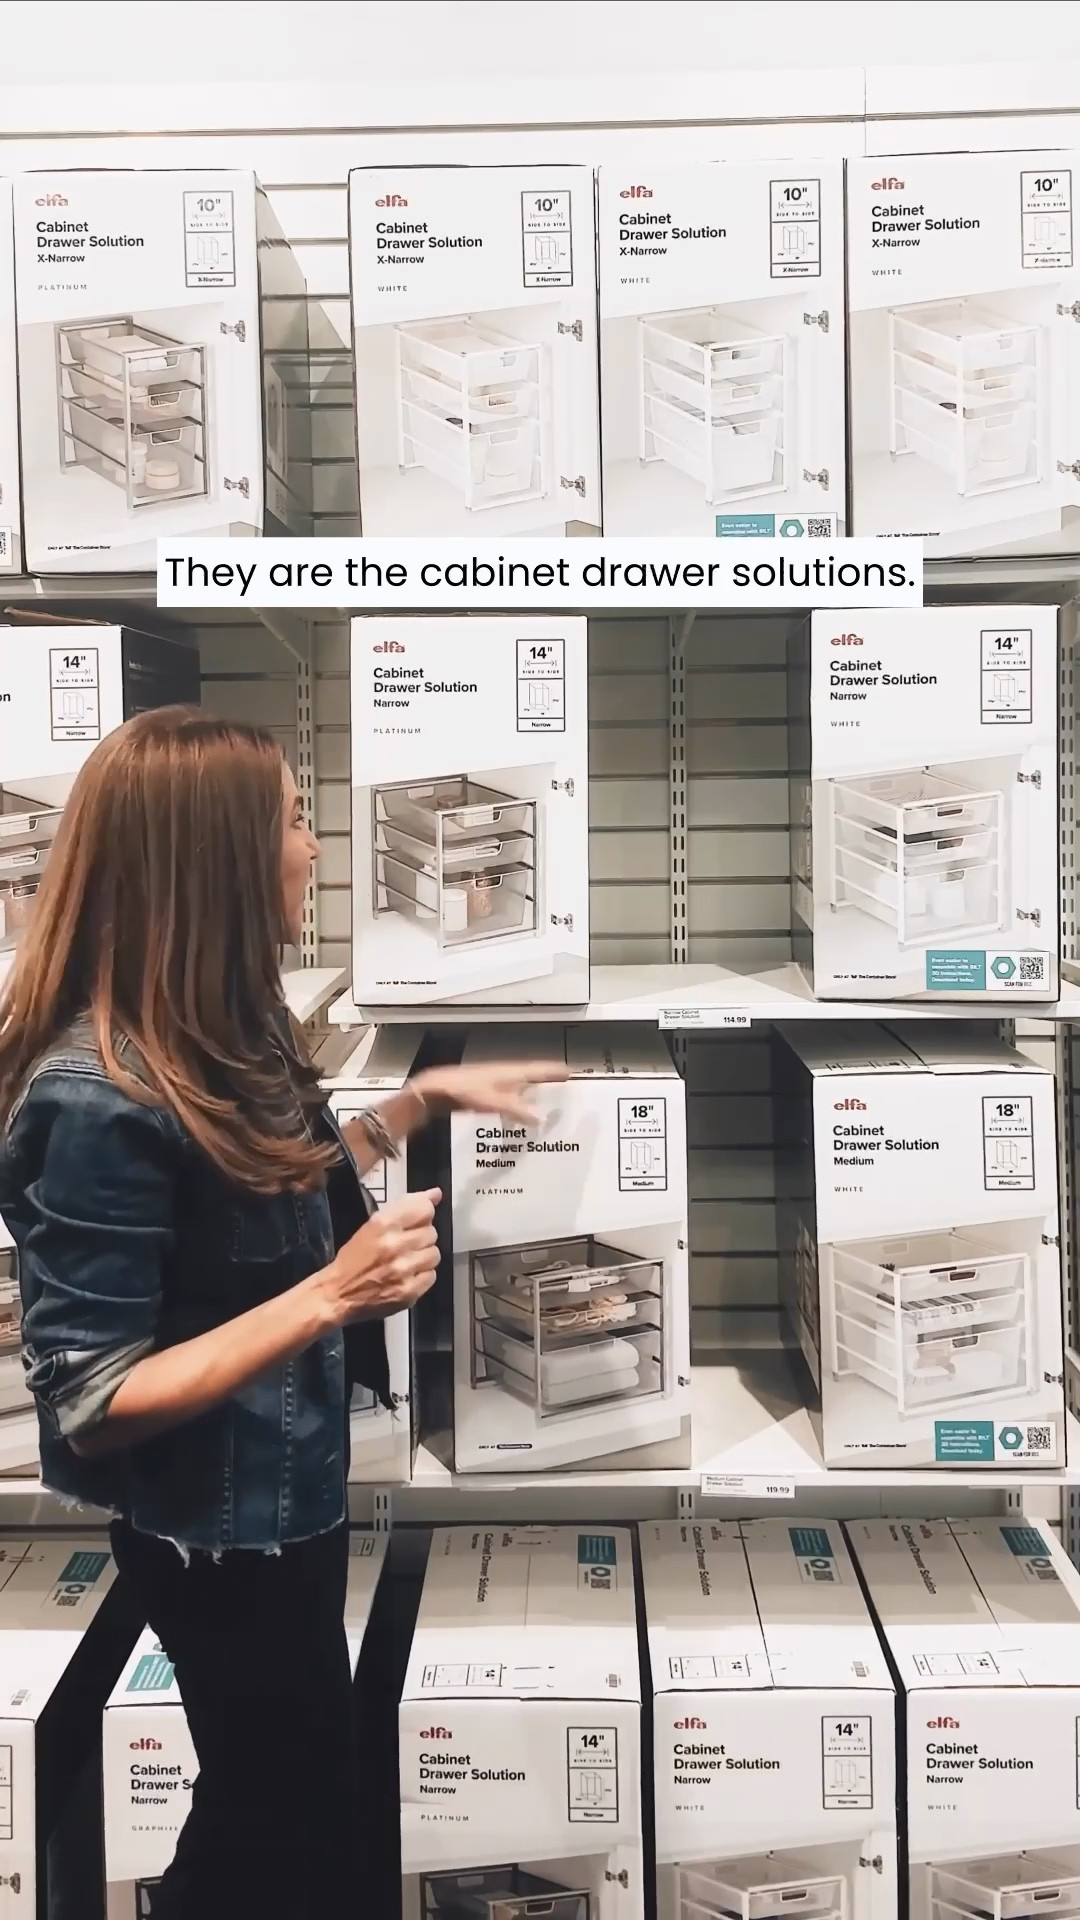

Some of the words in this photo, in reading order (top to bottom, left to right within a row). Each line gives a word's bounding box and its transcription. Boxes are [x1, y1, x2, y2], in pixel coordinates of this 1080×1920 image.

[871, 177, 905, 191] elfa
[619, 186, 653, 198] elfa
[375, 194, 408, 207] elfa
[871, 205, 925, 217] Cabinet
[619, 213, 672, 225] Cabinet
[872, 220, 921, 232] Drawer
[924, 218, 980, 230] Solution
[36, 221, 89, 233] Cabinet
[376, 222, 428, 234] Cabinet
[619, 228, 668, 240] Drawer
[671, 226, 727, 239] Solution
[37, 236, 85, 248] Drawer
[89, 236, 144, 247] Solution
[377, 238, 425, 249] Drawer
[428, 236, 483, 248] Solution
[872, 238, 920, 248] X-Narrow
[619, 246, 668, 256] X-Narrow
[37, 254, 85, 263] X-Narrow
[377, 255, 425, 264] X-Narrow
[830, 634, 864, 646] elfa
[373, 641, 406, 653] elfa
[63, 655, 86, 668] 14"
[830, 660, 882, 671] Cabinet
[373, 667, 424, 679] Cabinet
[830, 675, 878, 686] Drawer
[882, 673, 938, 685] Solution
[373, 681, 421, 693] Drawer
[424, 681, 478, 693] Solution
[830, 692, 867, 700] Narrow
[373, 699, 410, 707] Narrow
[833, 1098, 867, 1111] elfa
[476, 1127, 527, 1139] Cabinet
[833, 1125, 885, 1136] Cabinet
[476, 1142, 524, 1154] Drawer
[527, 1140, 580, 1152] Solution
[833, 1140, 881, 1151] Drawer
[885, 1139, 940, 1151] Solution
[476, 1158, 516, 1168] Medium
[833, 1157, 874, 1165] Medium
[673, 1717, 707, 1729] elfa
[926, 1716, 960, 1729] elfa
[419, 1727, 453, 1739] elfa
[129, 1738, 163, 1750] elfa
[674, 1744, 725, 1755] Cabinet
[926, 1743, 978, 1755] Cabinet
[419, 1753, 471, 1765] Cabinet
[674, 1759, 722, 1770] Drawer
[725, 1758, 780, 1770] Solution
[926, 1758, 975, 1769] Drawer
[978, 1758, 1034, 1769] Solution
[130, 1764, 182, 1776] Cabinet
[419, 1768, 467, 1780] Drawer
[471, 1769, 526, 1781] Solution
[131, 1779, 179, 1790] Drawer
[674, 1776, 711, 1784] Narrow
[926, 1775, 964, 1784] Narrow
[419, 1785, 456, 1794] Narrow
[131, 1796, 168, 1805] Narrow
